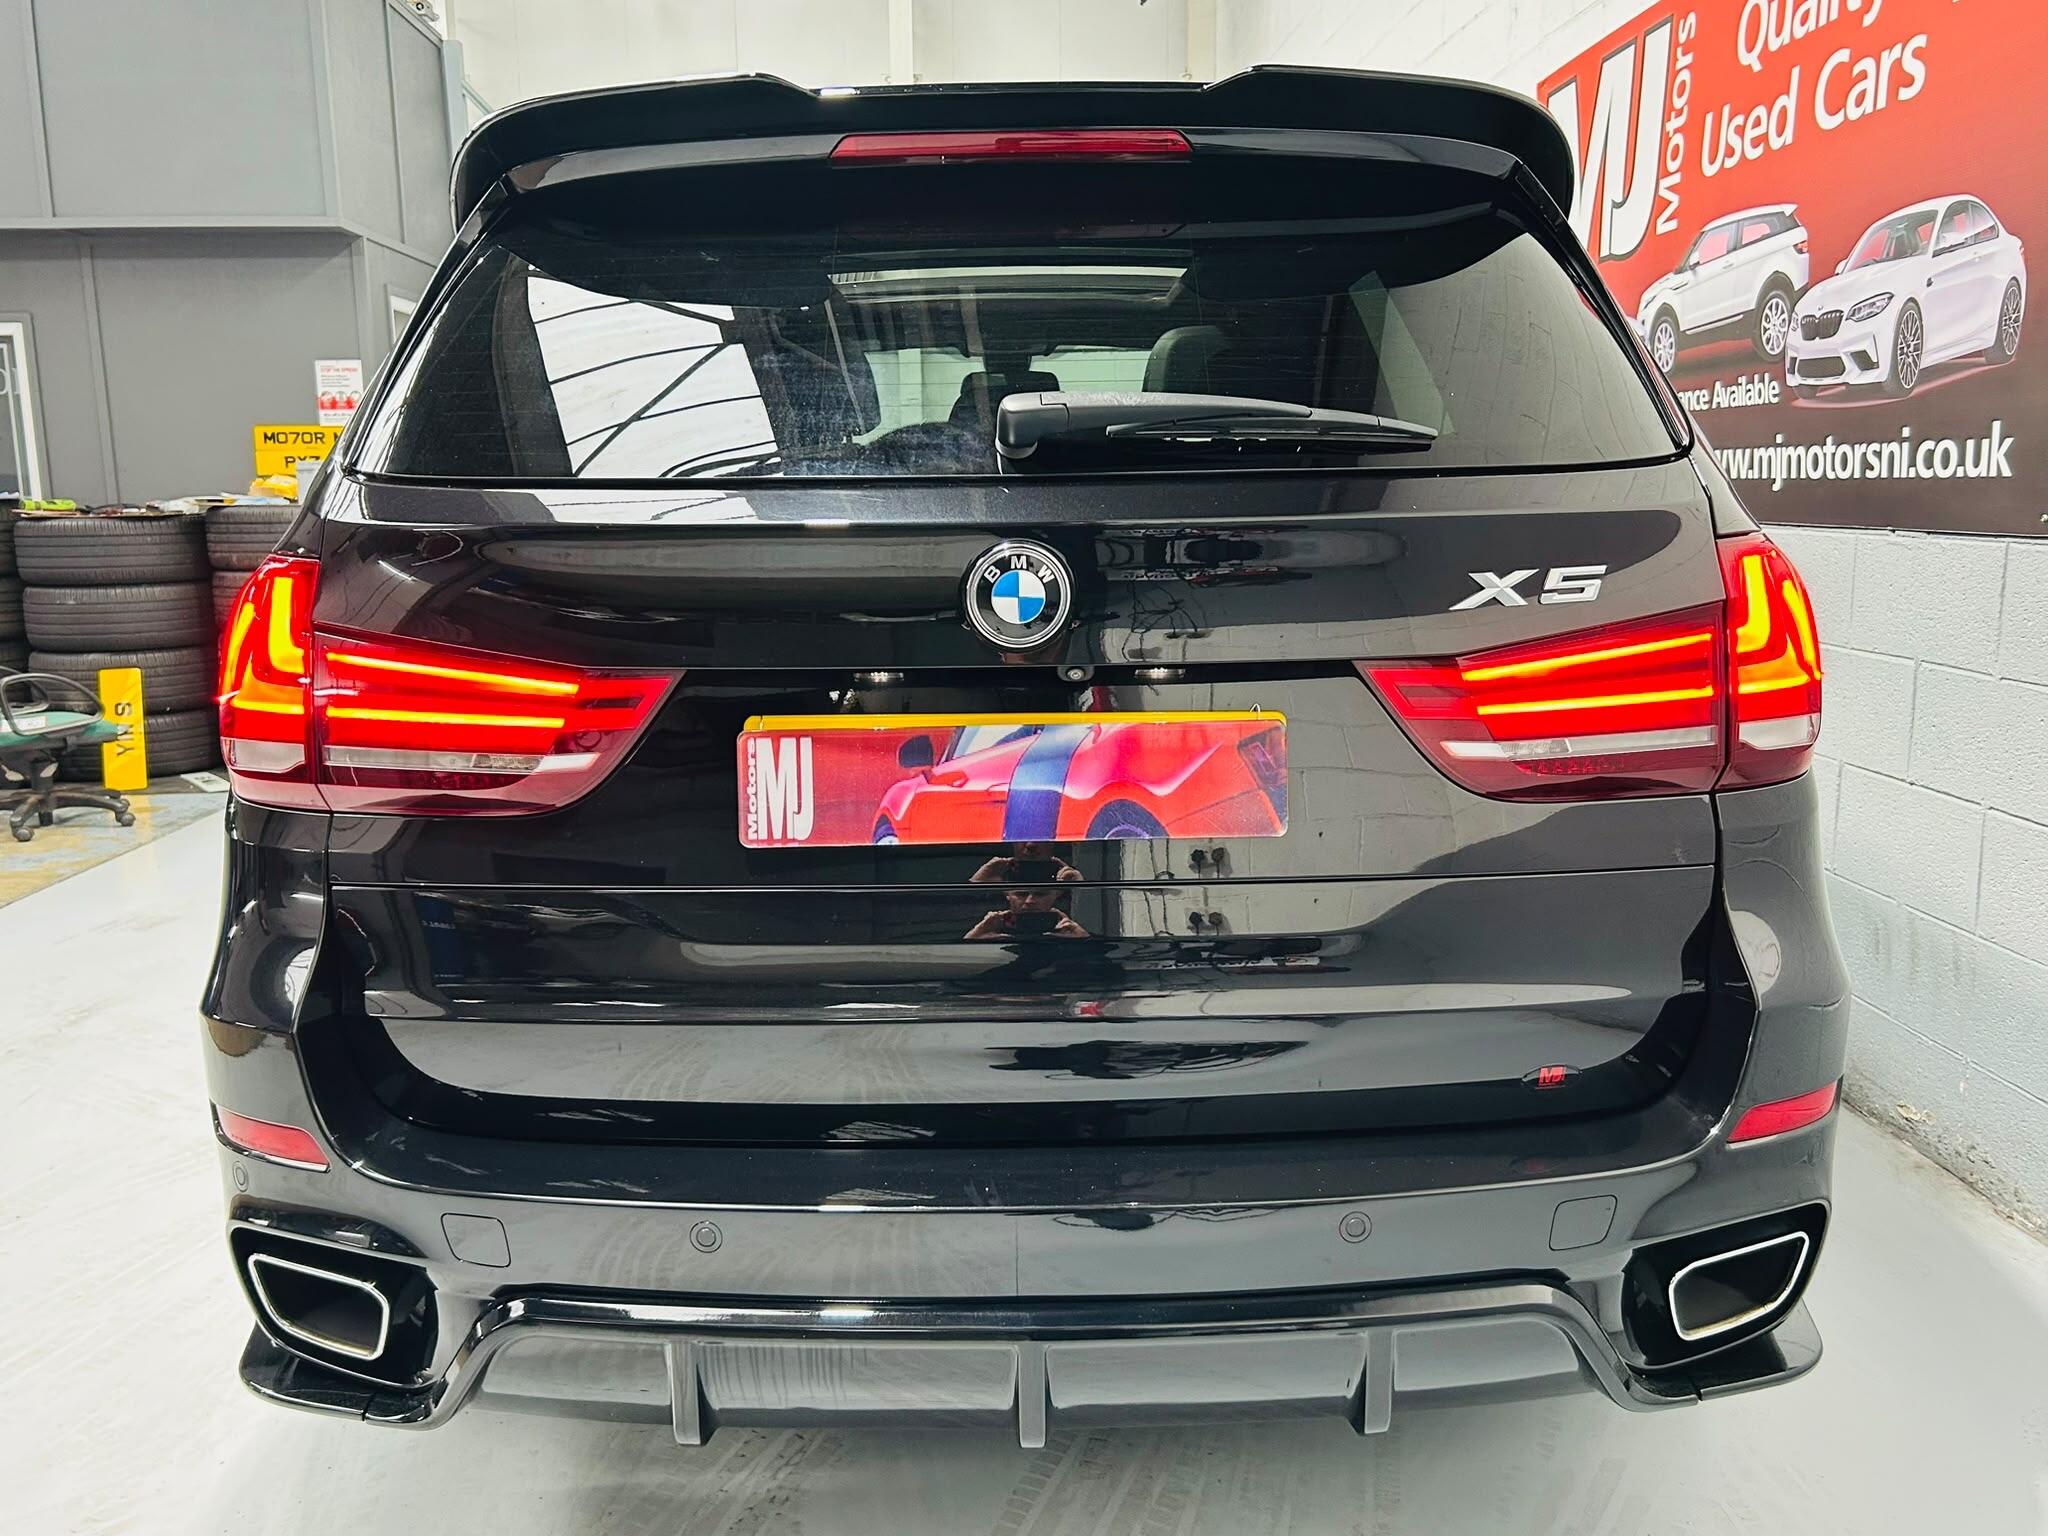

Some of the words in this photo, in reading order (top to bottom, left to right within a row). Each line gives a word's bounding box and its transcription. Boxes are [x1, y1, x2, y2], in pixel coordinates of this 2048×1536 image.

[1655, 11, 1697, 236] Motors
[1701, 65, 1800, 177] Used
[1814, 34, 1928, 131] Cars
[1711, 372, 1780, 409] Available
[983, 555, 1056, 584] BMW
[1448, 564, 1608, 611] X5
[747, 737, 758, 840] Motors
[756, 736, 815, 841] MJ
